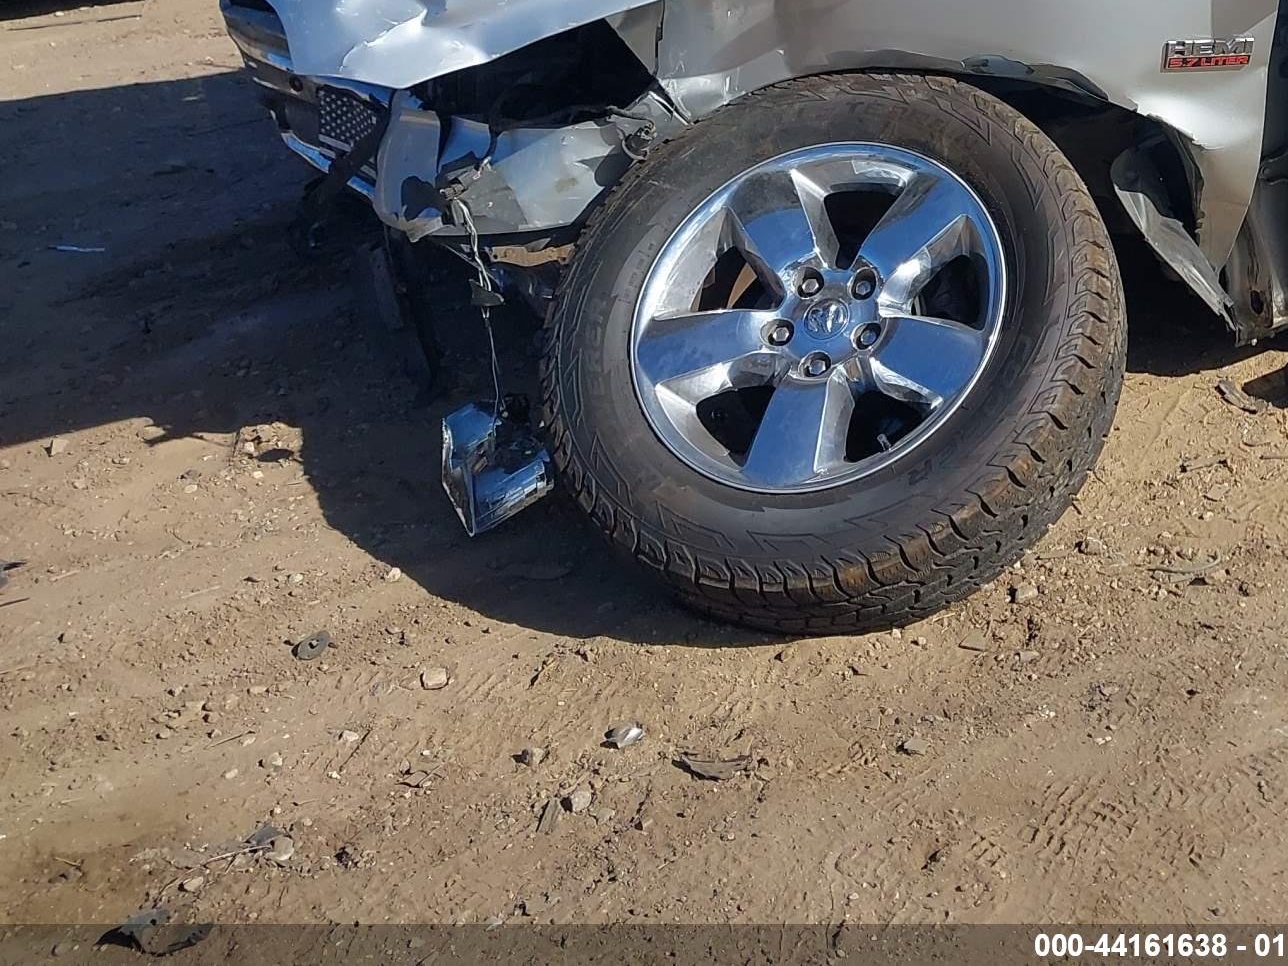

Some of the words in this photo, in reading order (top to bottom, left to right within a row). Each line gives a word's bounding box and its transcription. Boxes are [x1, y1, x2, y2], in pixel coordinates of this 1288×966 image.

[1166, 37, 1254, 57] HEMI
[1169, 57, 1199, 68] 5.7
[1200, 54, 1249, 66] LITER
